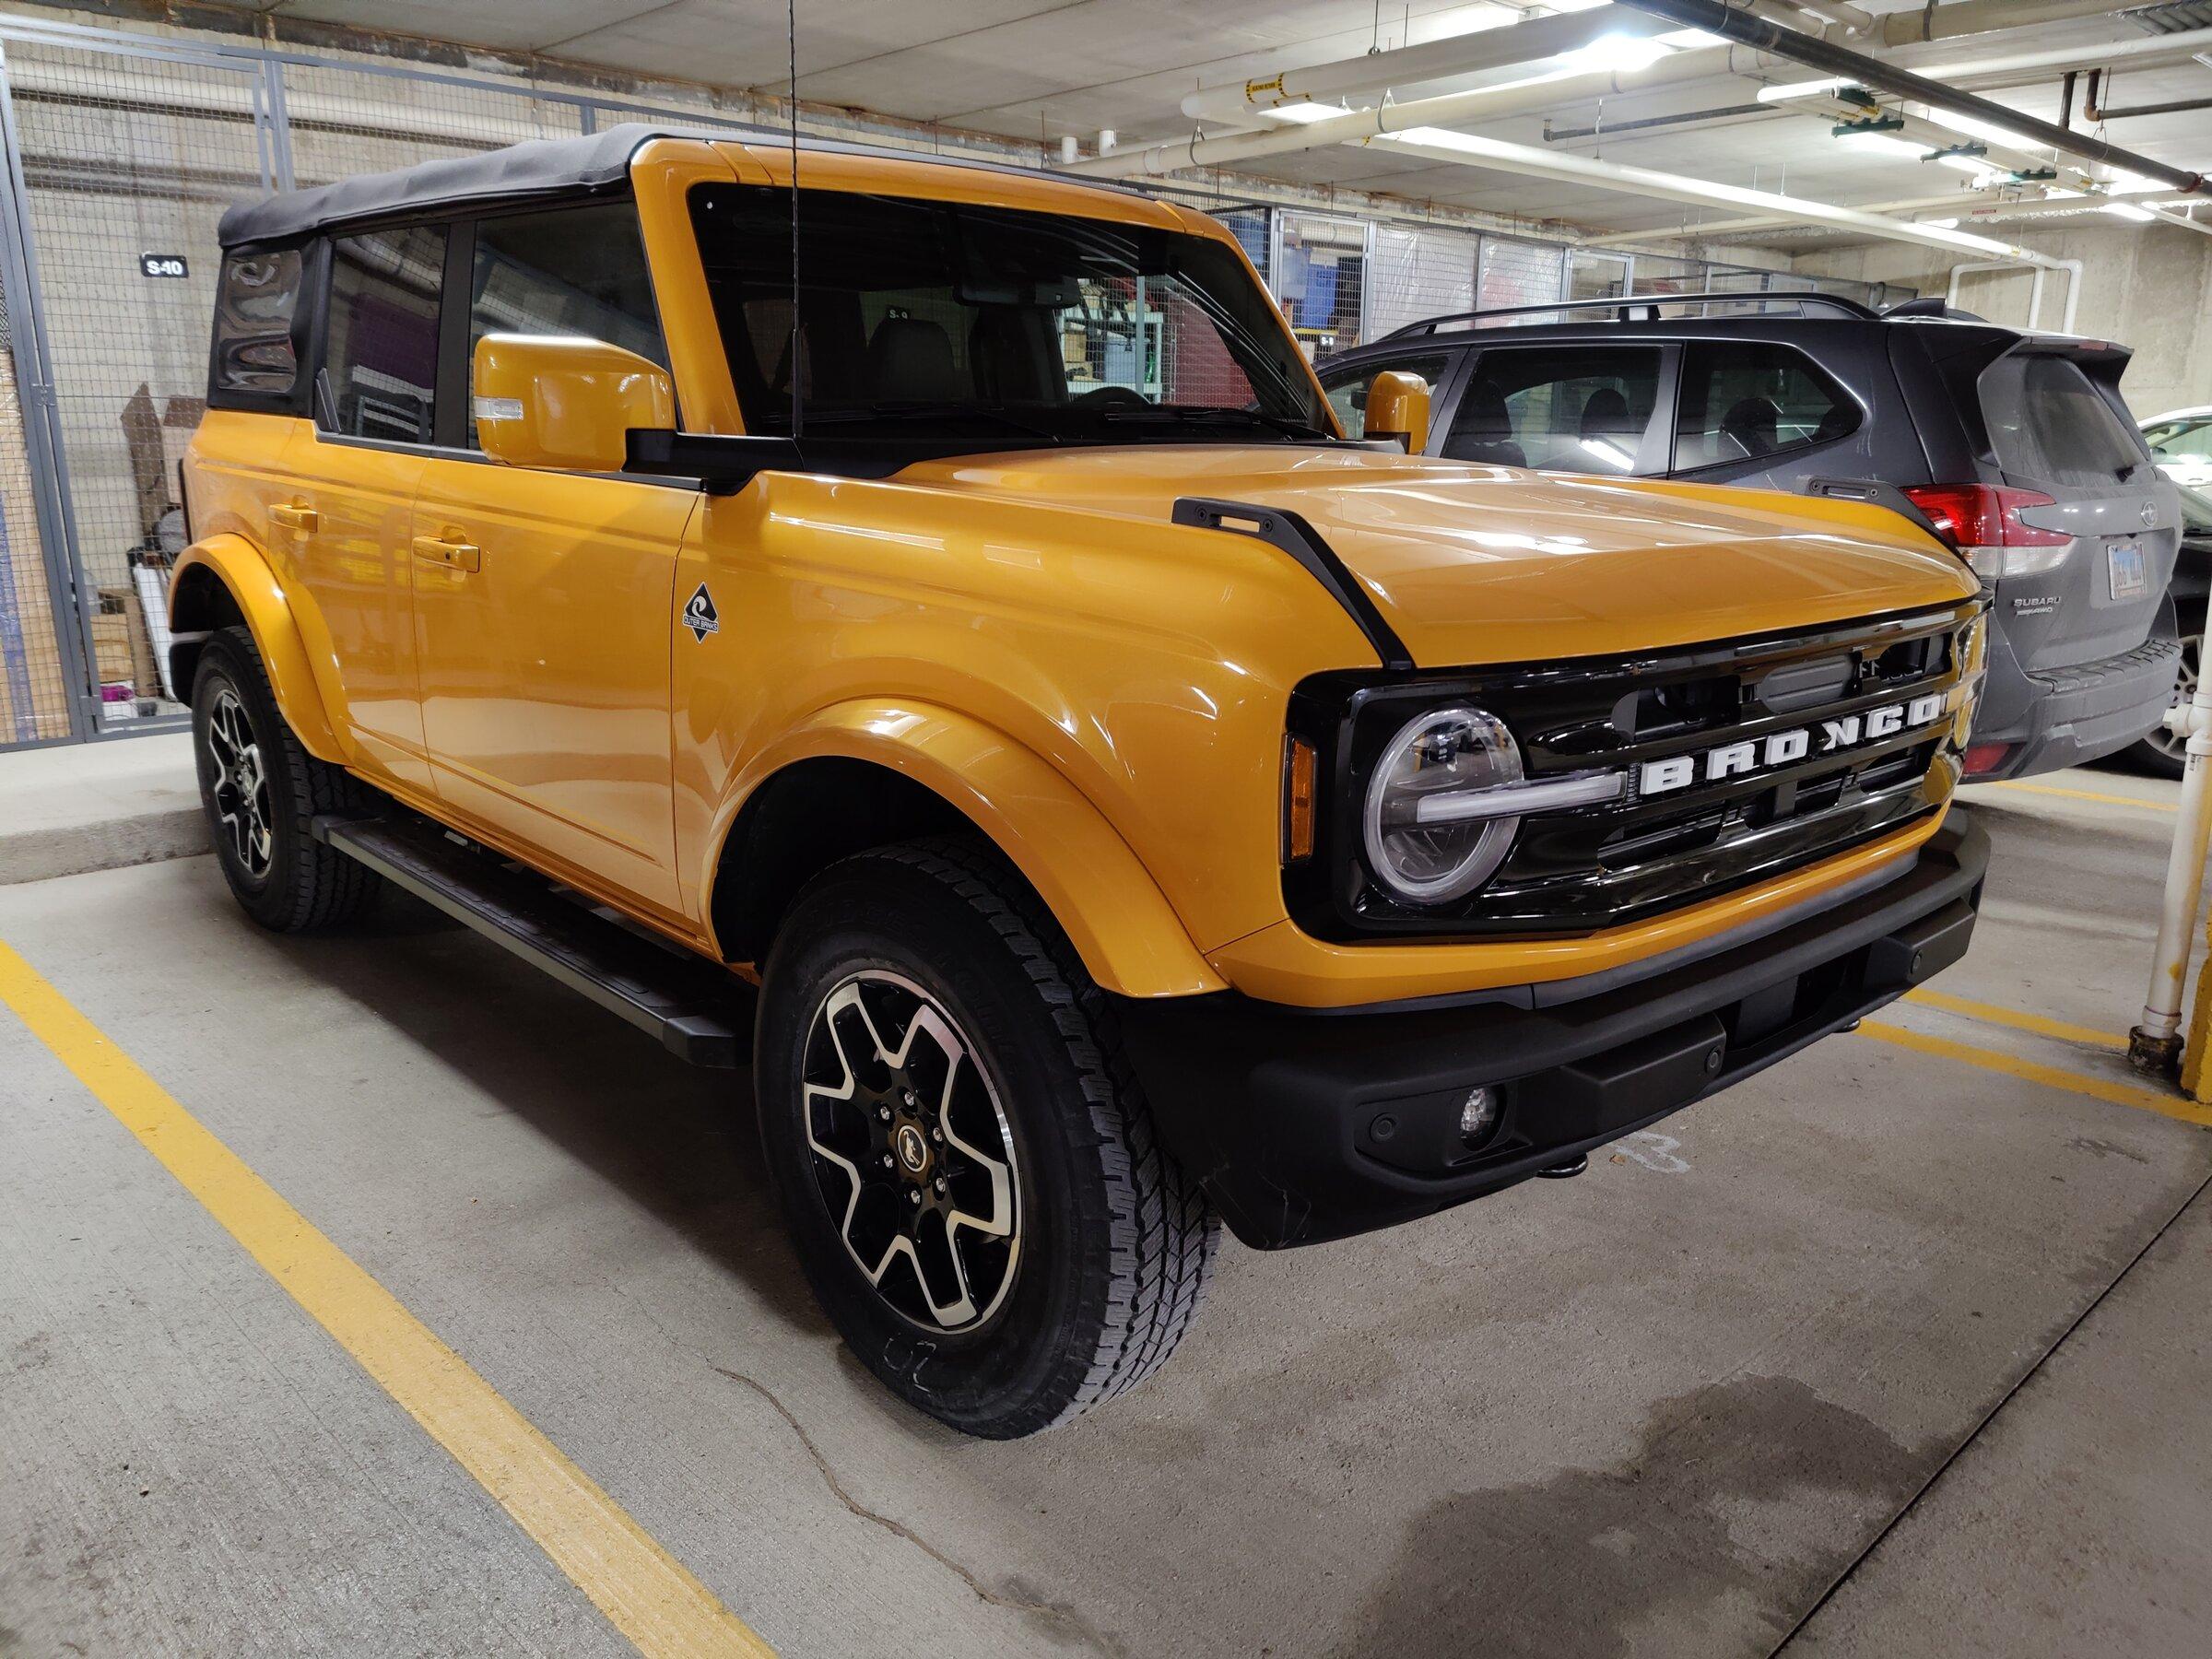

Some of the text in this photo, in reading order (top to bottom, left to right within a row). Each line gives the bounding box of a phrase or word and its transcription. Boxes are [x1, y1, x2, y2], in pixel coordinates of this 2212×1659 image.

[146, 260, 183, 276] S-10
[2013, 596, 2061, 607] SUBARU
[684, 617, 718, 630] OUTER BANKS
[1640, 693, 1942, 795] BRONCO
